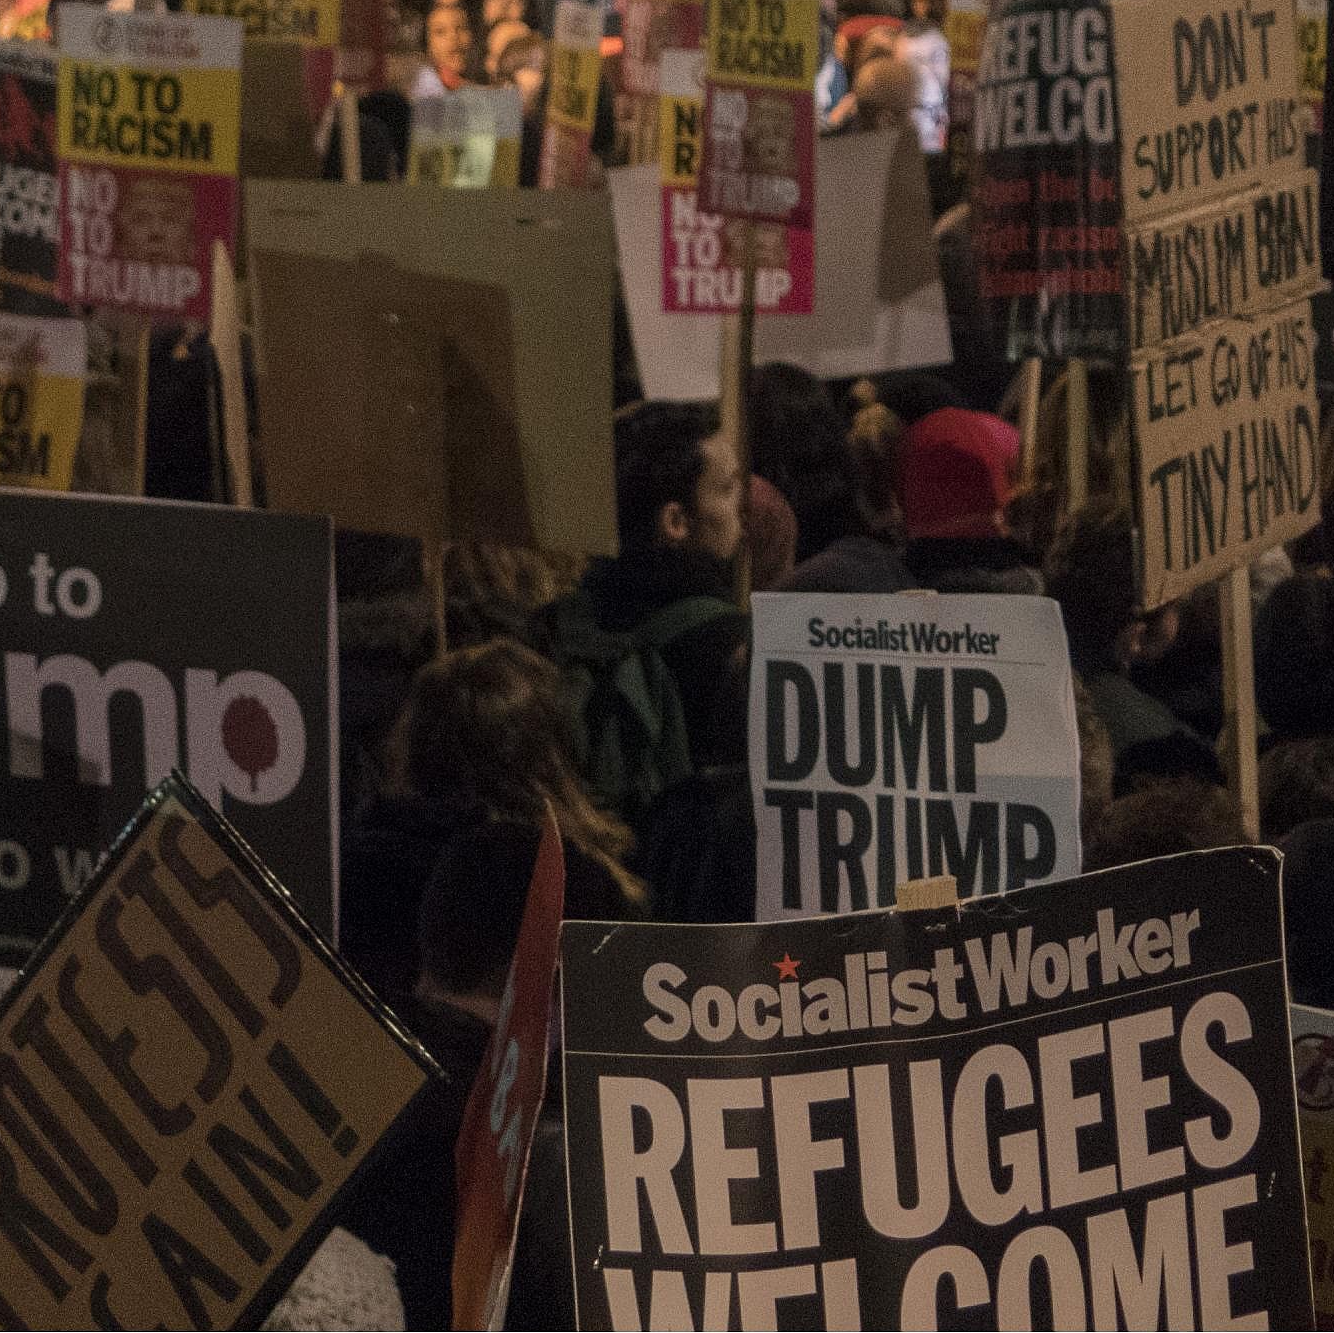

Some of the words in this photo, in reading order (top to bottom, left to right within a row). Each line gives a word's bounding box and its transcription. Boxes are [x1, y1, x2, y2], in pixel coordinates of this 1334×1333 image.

[981, 9, 1106, 84] REFUG
[71, 69, 118, 110] NO
[130, 73, 181, 116] TO
[974, 78, 1115, 154] WELCO
[71, 112, 213, 162] RACISM
[1134, 102, 1259, 202] SUPPORT
[1266, 97, 1300, 164] HIS
[68, 167, 117, 214] NO
[69, 213, 113, 256] TO
[672, 232, 720, 267] TO
[1133, 211, 1250, 347] MUSLIM
[1253, 184, 1317, 288] BAN
[69, 252, 201, 311] TRUMP
[1146, 344, 1205, 423] LET
[1208, 334, 1240, 408] GO
[1246, 323, 1274, 403] OF
[1150, 428, 1234, 573] TINY
[1237, 403, 1319, 543] HAND
[28, 550, 104, 621] to
[807, 616, 1001, 656] SocialistWorker
[765, 661, 1009, 794] DUMP
[765, 790, 1057, 915] TRUMP
[639, 905, 1203, 1045] SocialistWorker
[595, 989, 1265, 1259] REFUGEES
